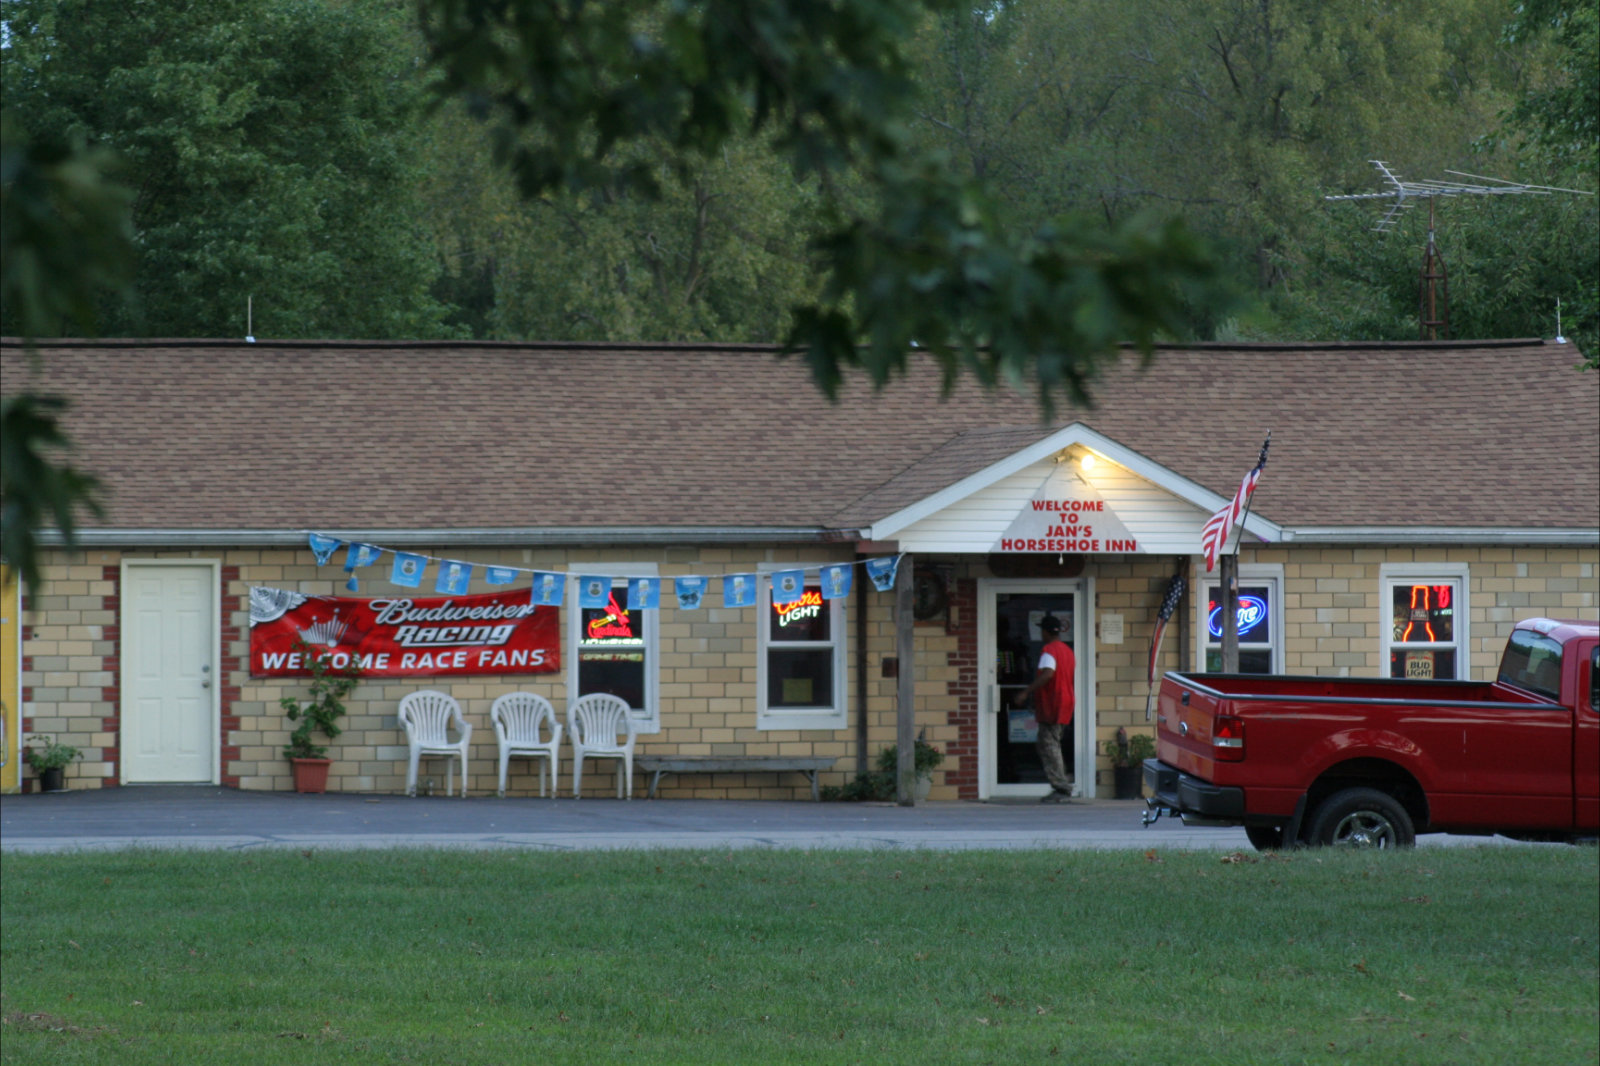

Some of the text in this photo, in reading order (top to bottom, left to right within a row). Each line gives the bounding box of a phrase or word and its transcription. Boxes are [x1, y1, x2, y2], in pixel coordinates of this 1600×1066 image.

[1032, 500, 1104, 511] WELCOME
[1059, 513, 1079, 523] TO
[1045, 526, 1092, 537] JAN'S
[1001, 539, 1136, 551] HORSESHOE INN
[368, 598, 536, 625] Budweiser
[779, 605, 820, 627] LIGHT
[400, 652, 468, 669] RACE
[478, 648, 546, 667] FANS
[1410, 660, 1430, 669] BUD
[1406, 669, 1432, 677] LIGHT
